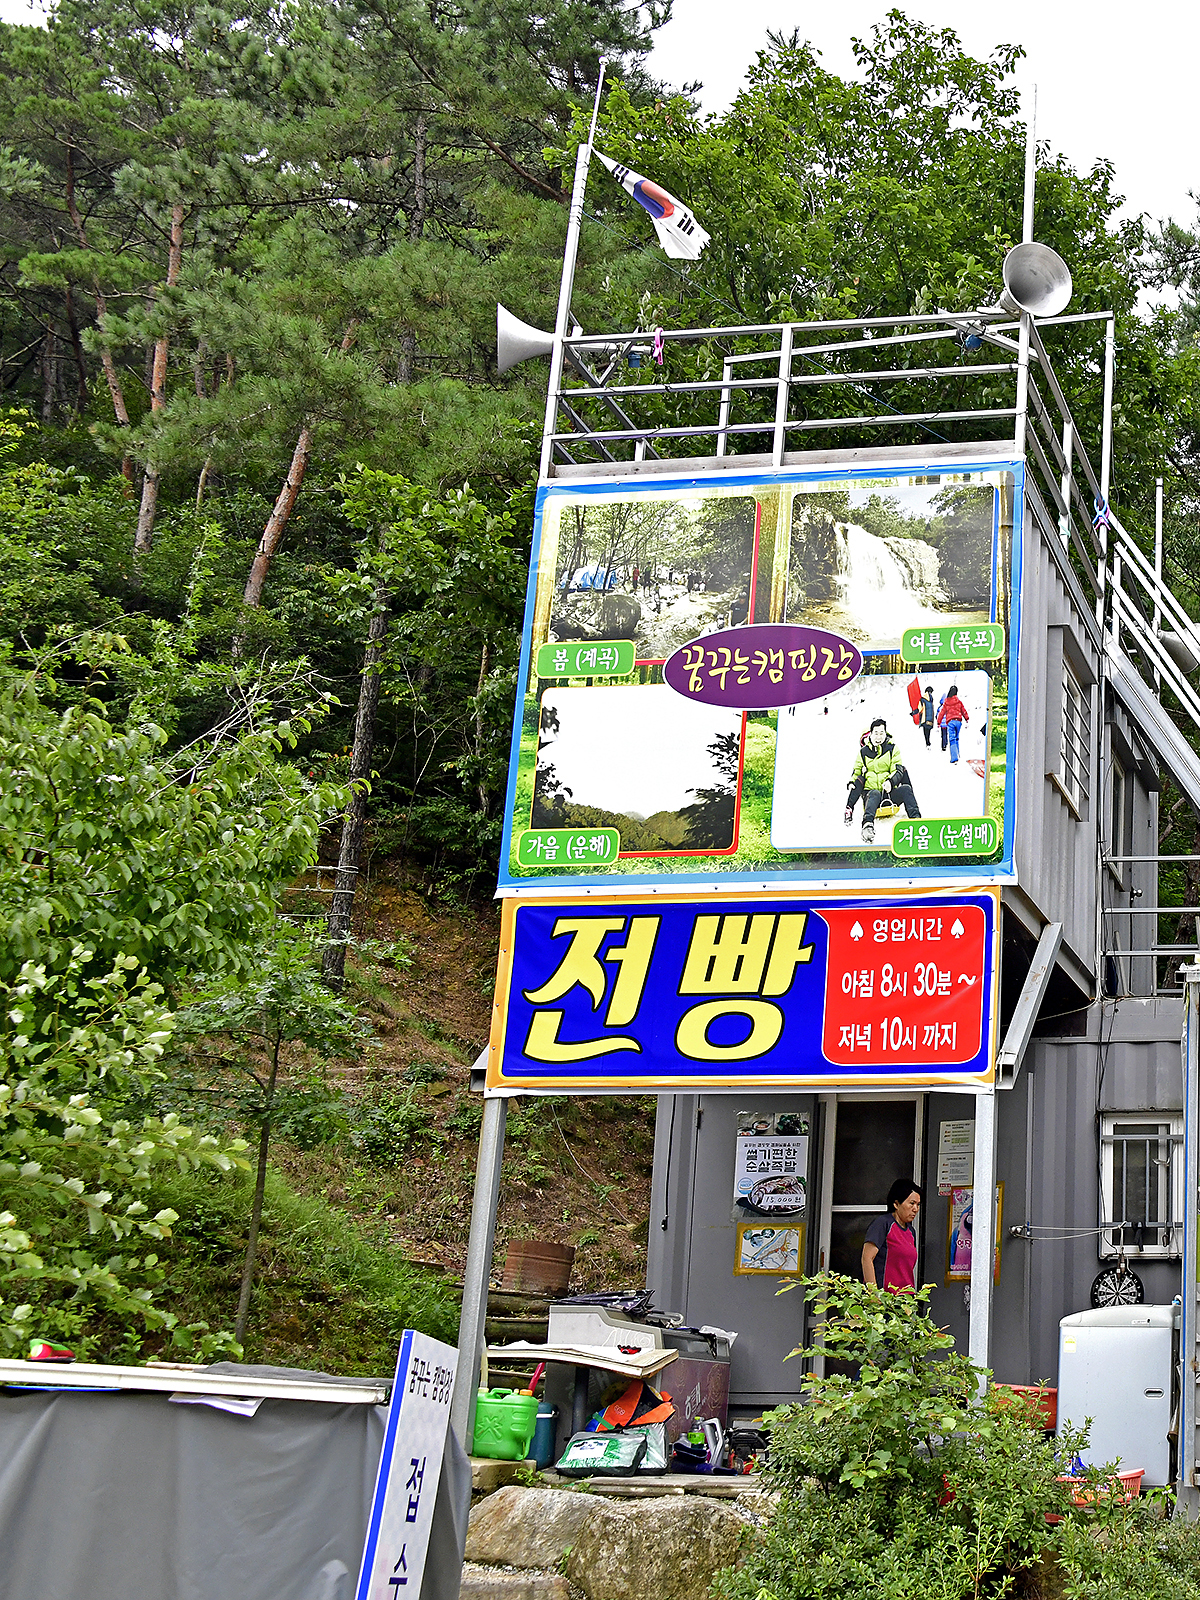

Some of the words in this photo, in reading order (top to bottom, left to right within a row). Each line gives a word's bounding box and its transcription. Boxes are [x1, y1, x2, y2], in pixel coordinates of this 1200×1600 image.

[910, 632, 943, 656] 여름
[950, 629, 996, 655] (폭포)
[552, 648, 570, 672] 봄
[575, 647, 619, 671] (계곡)
[526, 835, 560, 860] 가을
[566, 834, 611, 860] (운해)
[898, 824, 932, 850] 겨울
[939, 822, 994, 850] (눈썰매)
[872, 917, 943, 943] 영업시간
[841, 969, 875, 999] 아침
[880, 962, 908, 998] 8시
[912, 961, 953, 997] 30분
[838, 1022, 872, 1052] 저녁
[880, 1016, 917, 1051] 10시
[922, 1021, 957, 1051] 까지
[745, 1160, 797, 1173] 순살족발
[746, 1148, 798, 1161] 썰기편한
[409, 1357, 430, 1398] 꿈꾸는
[432, 1366, 454, 1405] 캠핑장
